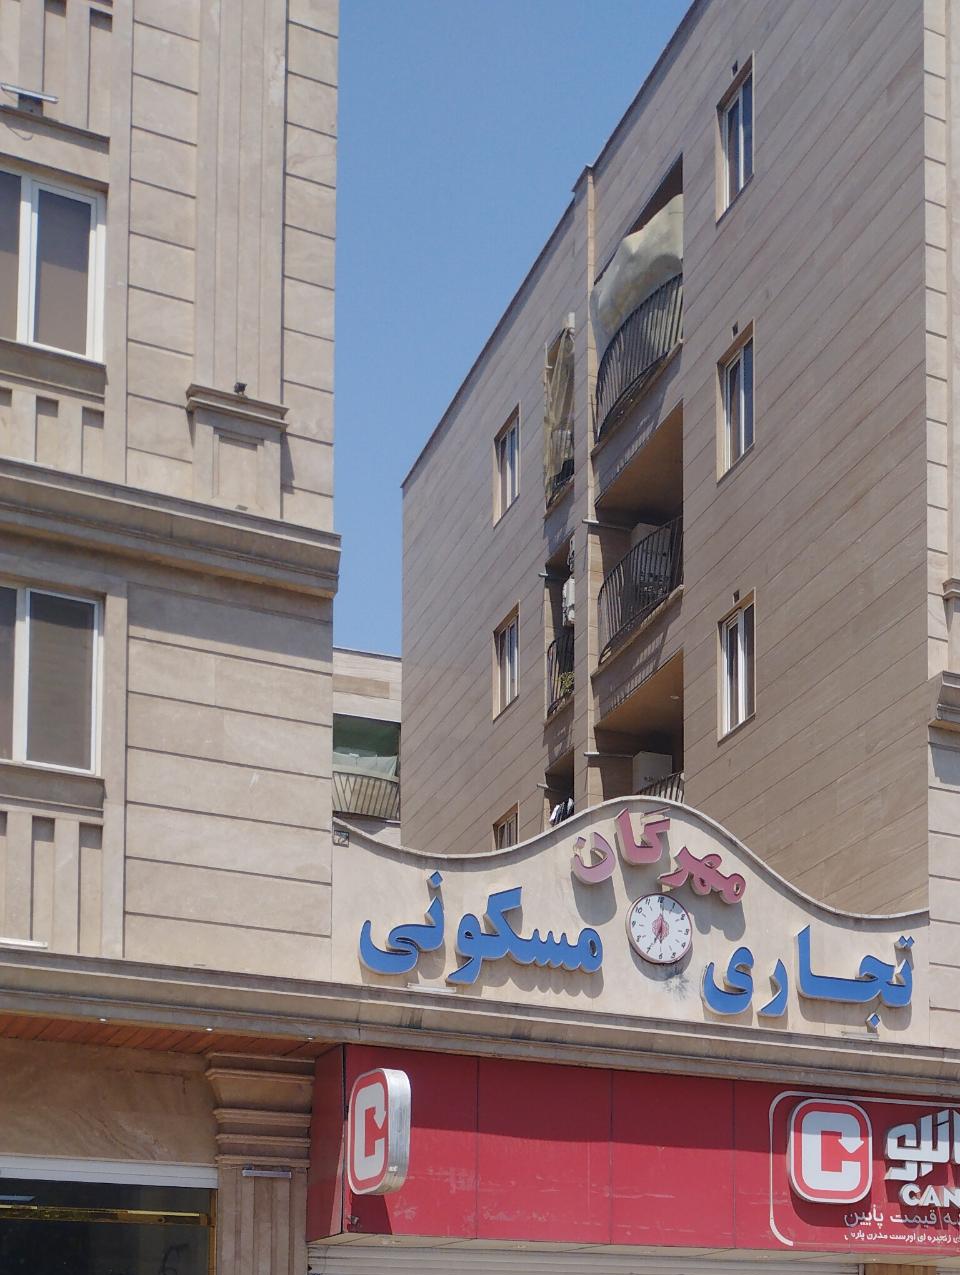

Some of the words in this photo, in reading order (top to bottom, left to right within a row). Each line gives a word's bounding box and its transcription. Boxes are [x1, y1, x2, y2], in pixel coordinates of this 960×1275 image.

[572, 807, 746, 904] مهرگان
[359, 871, 603, 985] مسکونی
[702, 926, 915, 1029] تجاری
[889, 1209, 937, 1228] قیمت
